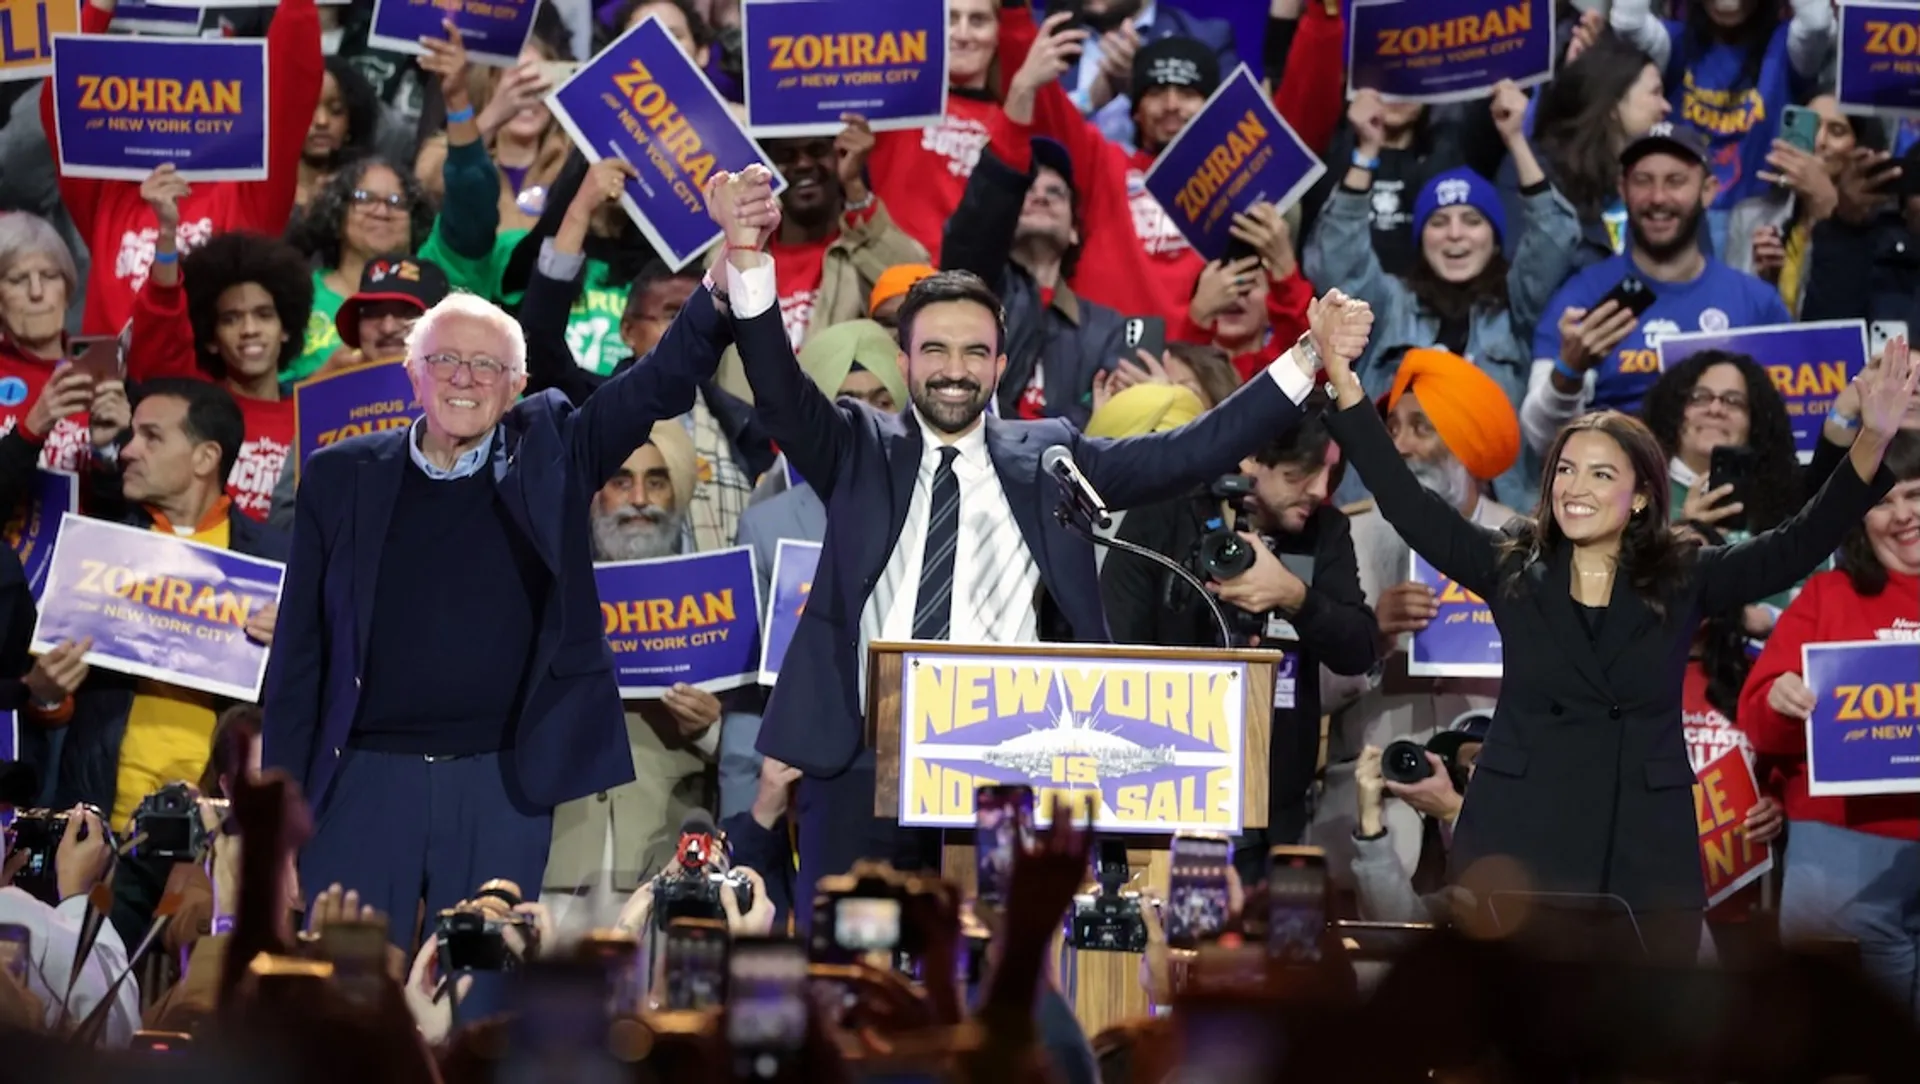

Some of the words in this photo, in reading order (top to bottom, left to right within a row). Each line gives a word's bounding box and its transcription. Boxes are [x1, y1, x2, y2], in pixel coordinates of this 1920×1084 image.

[1376, 2, 1532, 56] ZOHRAN
[768, 29, 928, 71] ZOHRAN
[1406, 55, 1444, 68] NEW
[1447, 46, 1488, 63] YORK
[1491, 38, 1525, 55] CITY
[76, 74, 243, 114] ZOHRAN
[801, 73, 841, 87] NEW
[842, 70, 884, 86] YORK
[885, 68, 921, 84] CITY
[108, 116, 144, 132] NEW
[147, 117, 191, 134] YORK
[194, 118, 234, 134] CITY
[611, 57, 716, 194] ZOHRA
[617, 107, 649, 145] NEW
[645, 142, 678, 184] YORK
[672, 180, 704, 213] CITY
[1174, 107, 1268, 223] ZOHRAN
[349, 399, 405, 419] HINDUS
[72, 558, 253, 628] ZOHRAN
[103, 603, 145, 624] NEW
[148, 612, 193, 634] YORK
[196, 624, 237, 644] CITY
[609, 638, 638, 654] EW
[641, 635, 689, 652] YORK
[690, 628, 729, 647] CITY
[913, 664, 1054, 745] NEW
[1062, 667, 1233, 753] YORK
[1834, 683, 1920, 722] ZOH
[1871, 724, 1914, 741] NEW
[1051, 754, 1098, 784] IS
[1116, 765, 1232, 823] SALE
